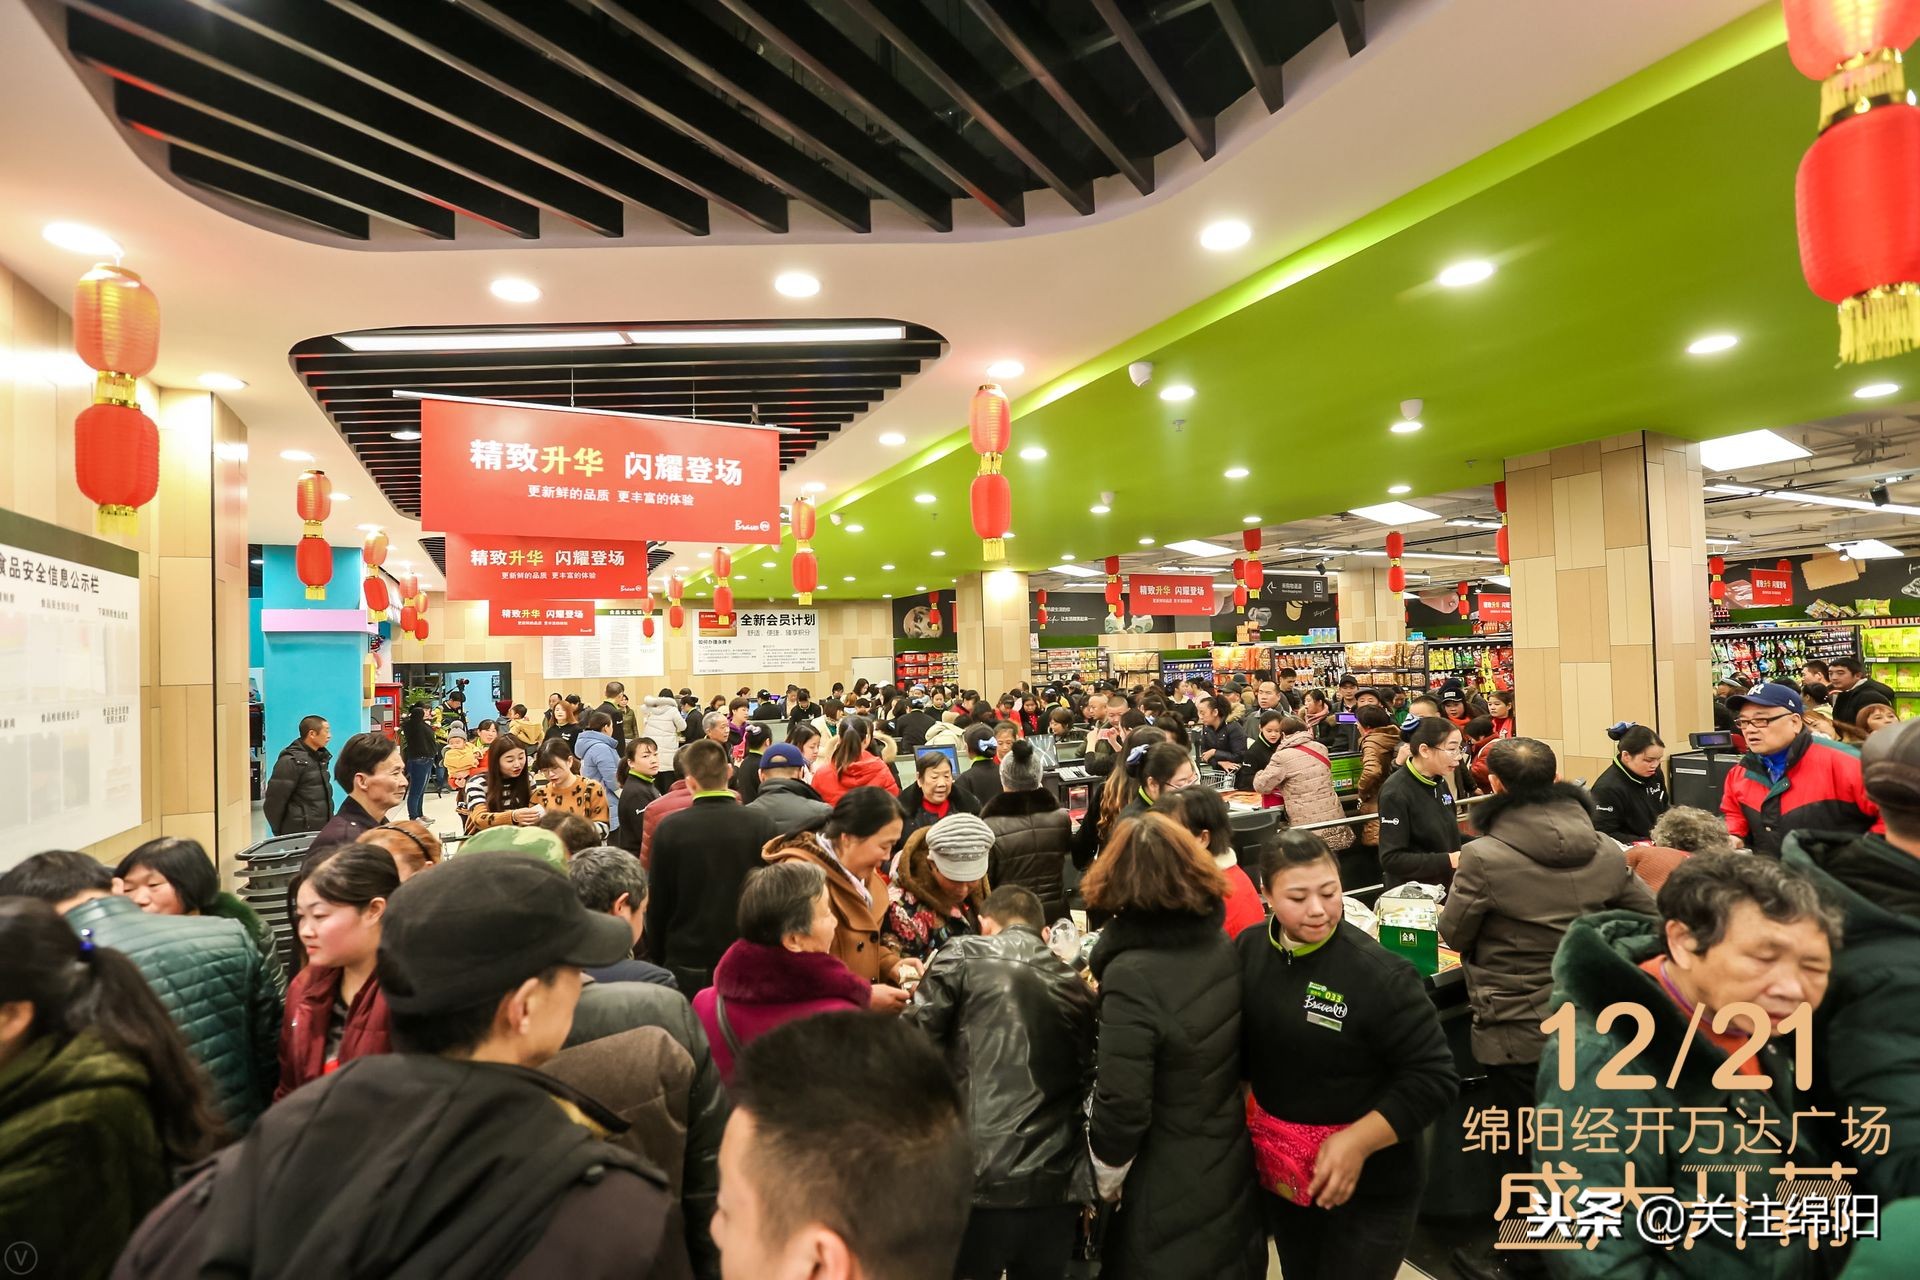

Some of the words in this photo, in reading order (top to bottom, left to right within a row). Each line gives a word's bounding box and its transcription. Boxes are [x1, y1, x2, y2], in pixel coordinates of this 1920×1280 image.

[470, 439, 605, 477] 精致升华
[624, 452, 743, 486] 闪耀登场
[527, 484, 610, 502] 更新鲜的品质
[617, 490, 694, 507] 更丰富的体验
[470, 549, 544, 567] 精致升华
[555, 549, 625, 567] 闪耀登场
[501, 571, 547, 580] 更新鲜的品质
[551, 571, 597, 580] 更丰富的体验
[1139, 585, 1171, 595] 精致升华
[1174, 585, 1205, 596] 闪耀登场
[501, 609, 541, 619] 精致升华
[545, 609, 584, 619] 闪耀登场
[740, 613, 816, 626] 全新会员计划
[1401, 932, 1415, 942] 金典
[1325, 991, 1342, 1003] 033
